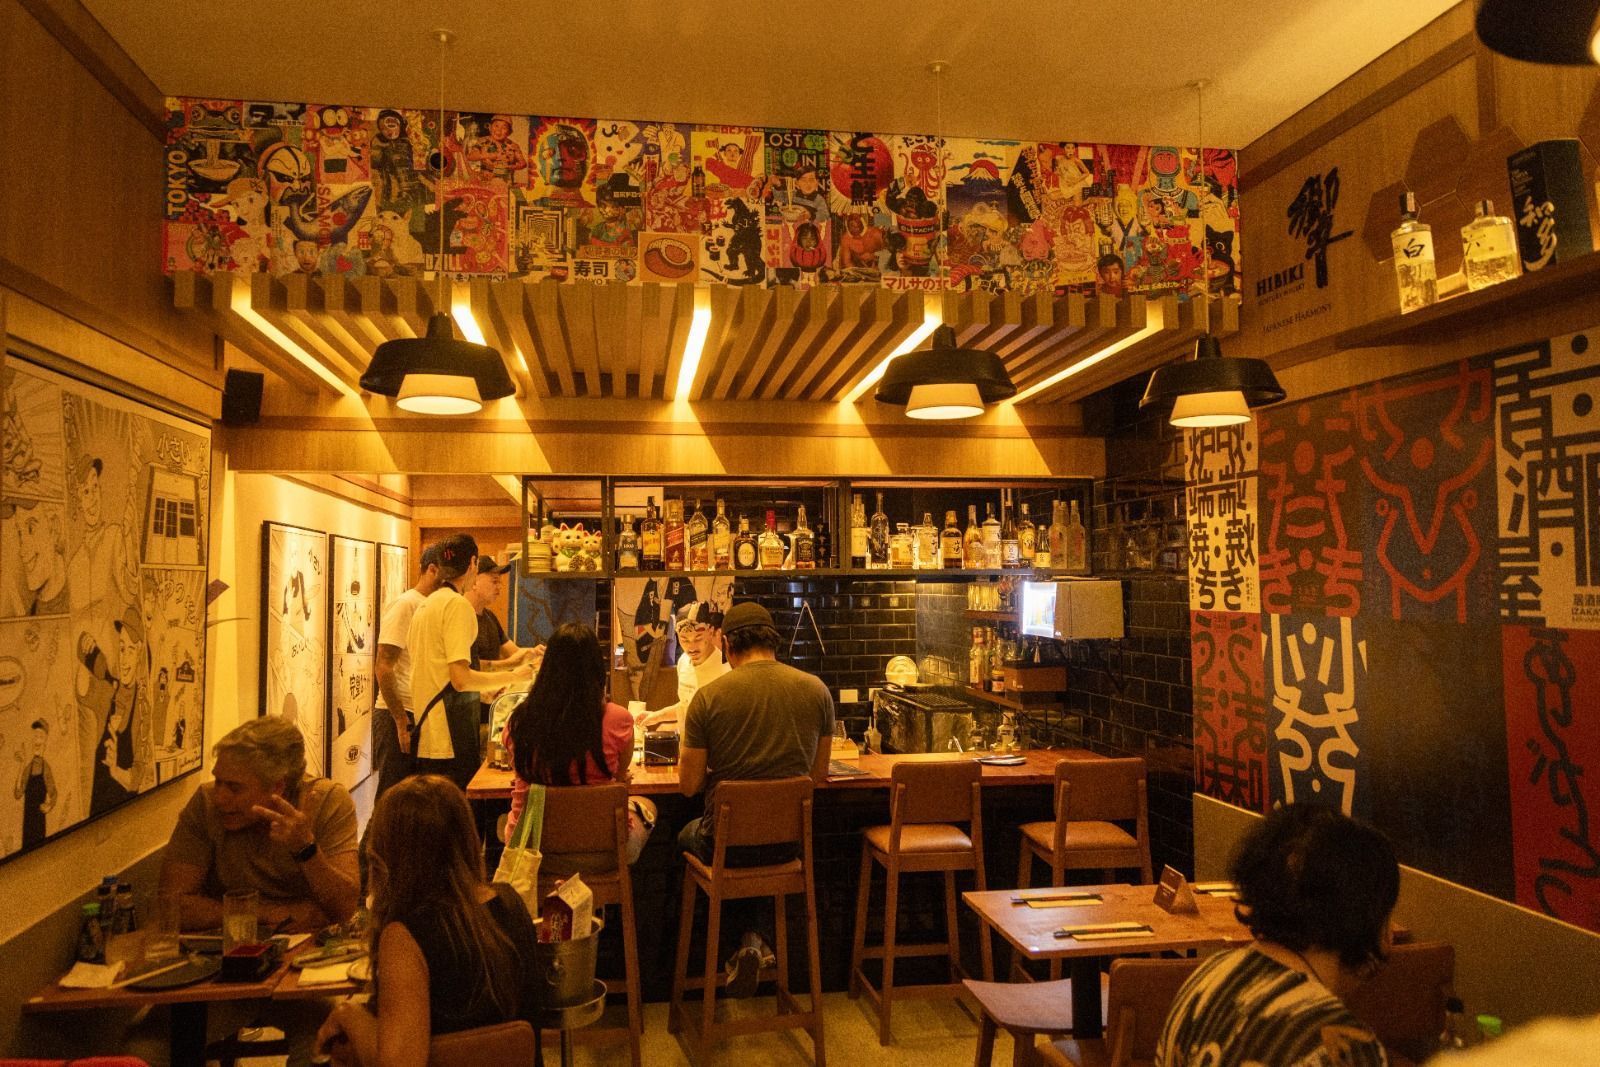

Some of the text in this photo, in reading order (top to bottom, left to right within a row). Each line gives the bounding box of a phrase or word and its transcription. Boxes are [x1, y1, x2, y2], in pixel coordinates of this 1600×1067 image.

[765, 133, 802, 147] OST
[801, 155, 817, 166] IN
[167, 149, 187, 216] TOKYO
[1403, 238, 1425, 258] 白
[574, 261, 609, 277] 寿司
[883, 277, 950, 291] マルサの女
[1256, 263, 1305, 296] HIBIKI
[1571, 607, 1600, 616] IZAKA
